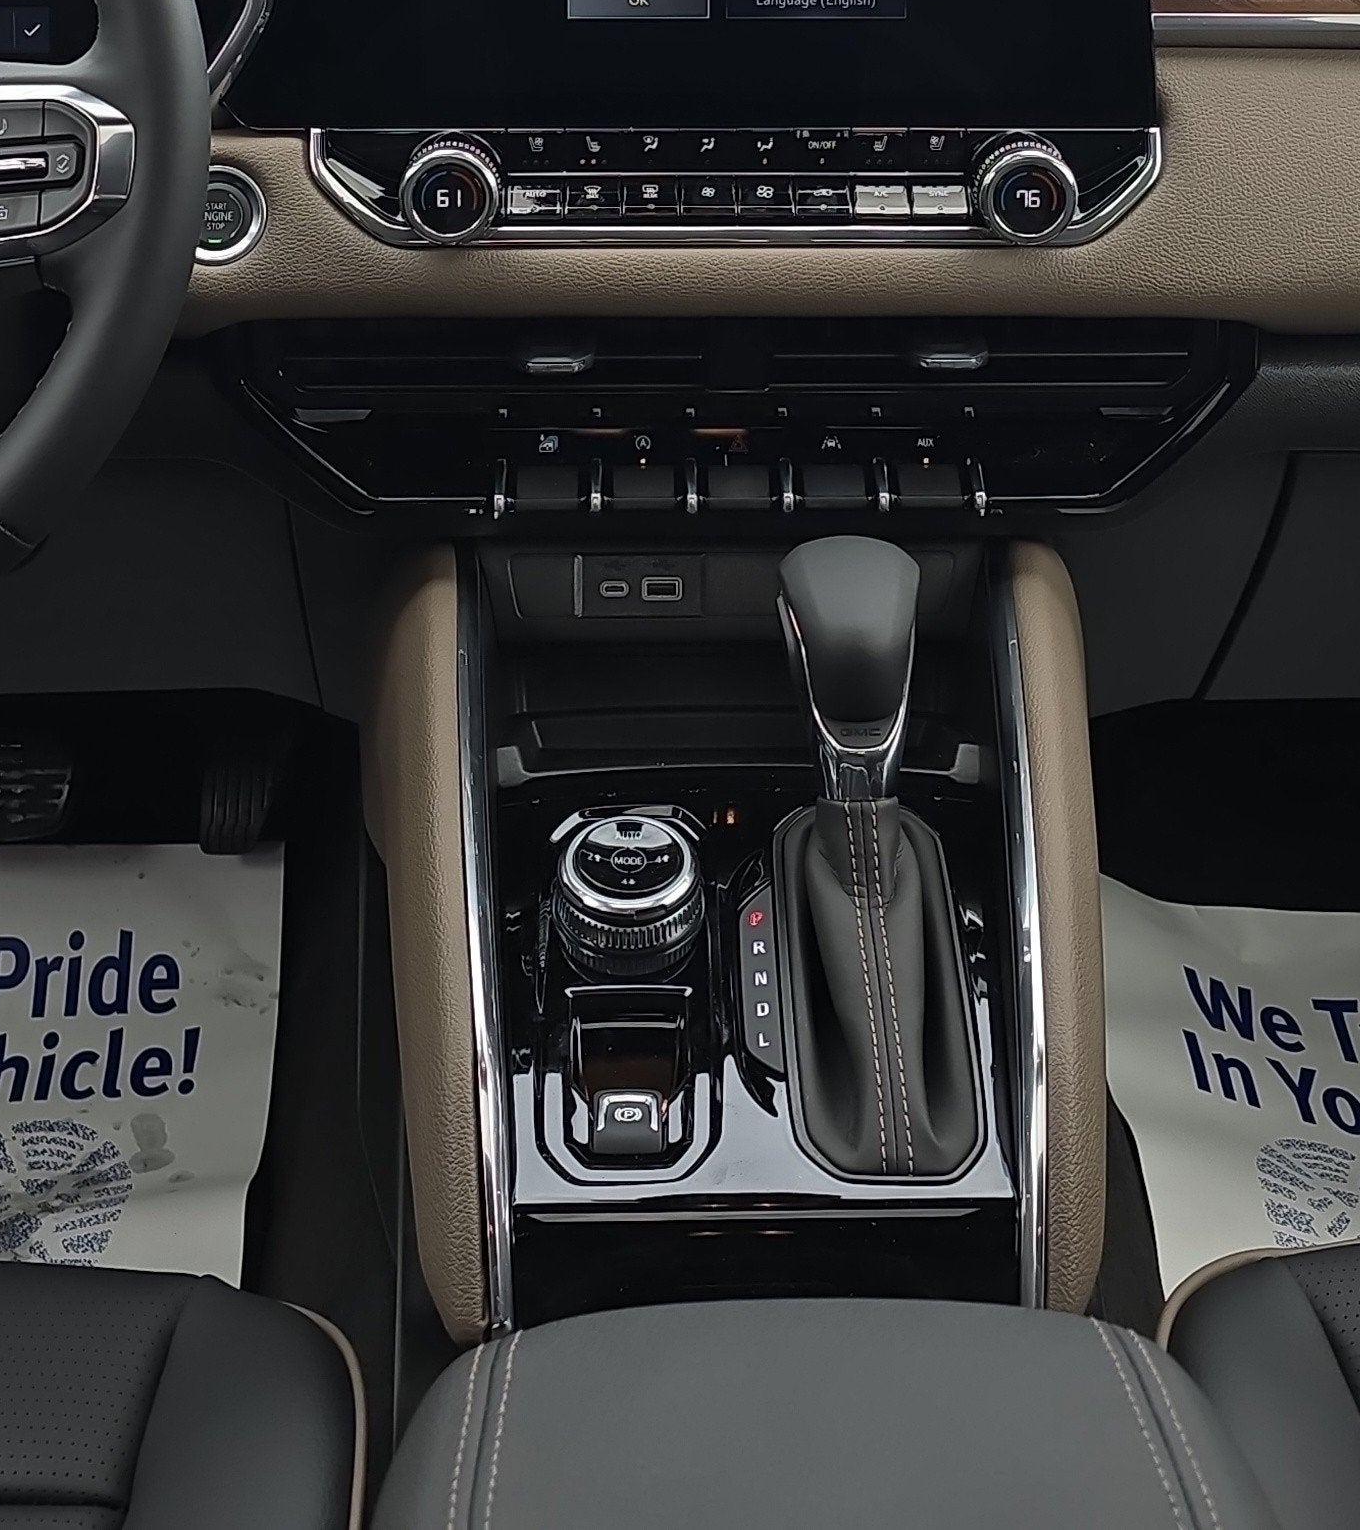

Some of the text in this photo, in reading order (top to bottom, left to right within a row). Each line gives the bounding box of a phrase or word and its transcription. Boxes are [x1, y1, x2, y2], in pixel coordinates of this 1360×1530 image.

[808, 140, 837, 150] ON/OFF
[436, 190, 463, 209] 61
[525, 190, 547, 198] AUTO
[1016, 190, 1040, 209] 76
[205, 201, 227, 211] START
[204, 211, 234, 222] NGINE
[206, 222, 226, 232] STOP
[917, 438, 934, 447] AUX
[615, 830, 643, 840] AUTO
[614, 856, 643, 865] MODE
[752, 940, 767, 955] R
[754, 971, 768, 986] N
[756, 1002, 770, 1016] D
[1181, 964, 1306, 1053] We
[758, 1033, 770, 1047] L
[1181, 1027, 1261, 1109] In
